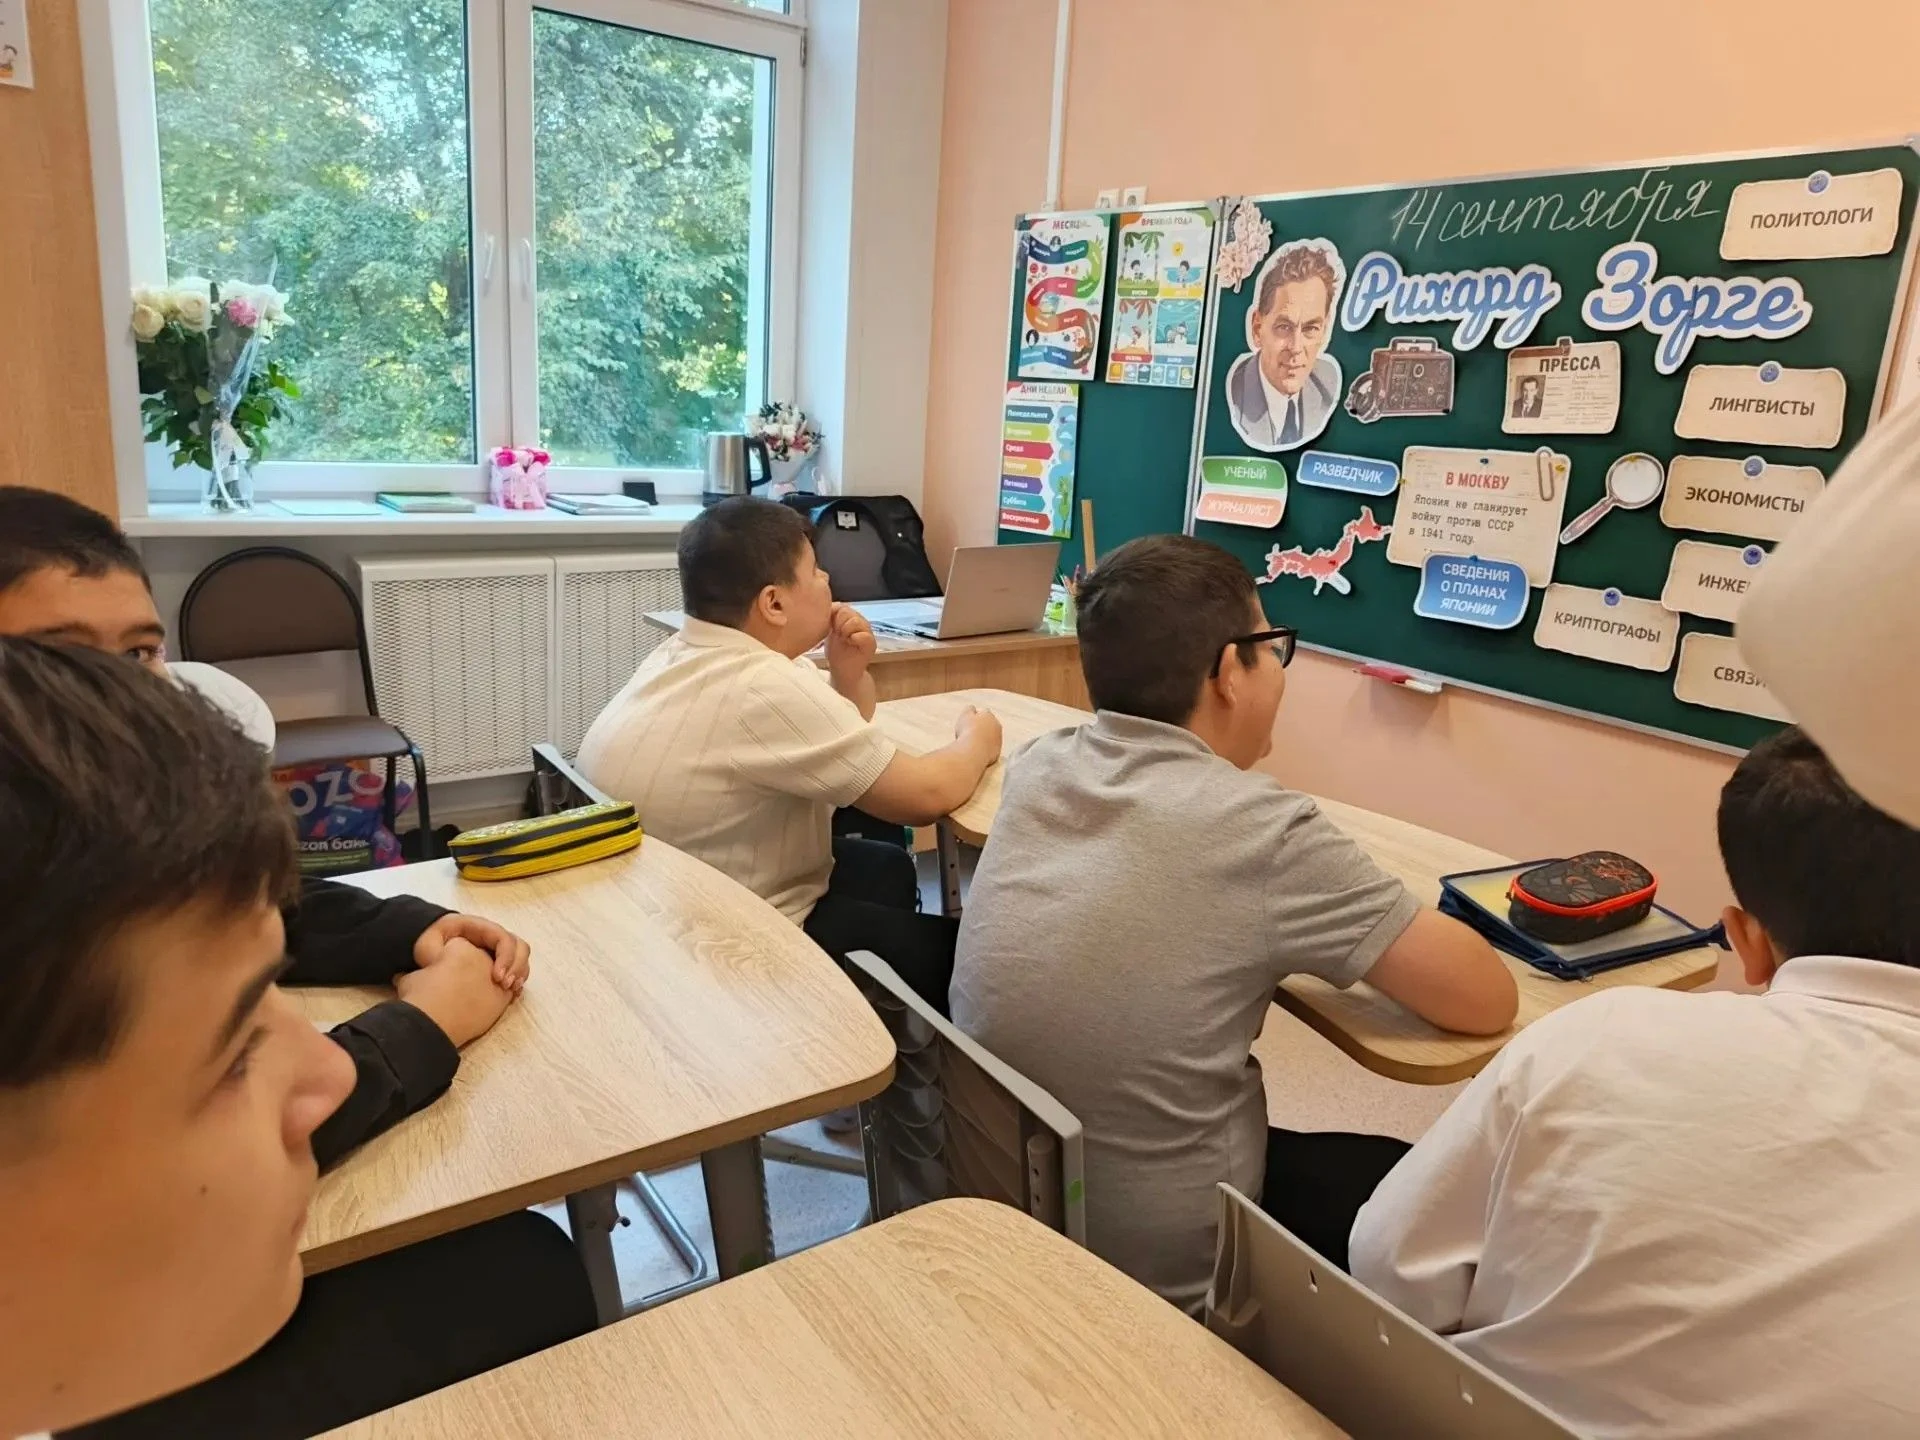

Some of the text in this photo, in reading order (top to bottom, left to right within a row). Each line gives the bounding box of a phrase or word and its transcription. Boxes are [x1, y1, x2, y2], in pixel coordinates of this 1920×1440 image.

[1391, 167, 1721, 251] 14 сентября
[1749, 207, 1874, 230] ПОЛИТОЛОГИ
[1345, 249, 1804, 367] Рихард Зорге
[1539, 356, 1601, 373] ПРЕССА
[1709, 396, 1815, 417] ЛИНГВИСТЫ
[1223, 465, 1268, 481] УЧЕНЫЙ
[1312, 461, 1384, 484] РАЗВЕДЧИК
[1445, 471, 1454, 486] В
[1458, 472, 1510, 490] МОСКВУ
[1207, 499, 1275, 517] ЖУРНАЛИСТ
[1414, 494, 1529, 516] Япония не планирует
[1684, 486, 1805, 513] ЭКОНОМИСТЫ
[1411, 511, 1515, 532] войну против СССР
[1408, 527, 1415, 536] в
[1422, 528, 1444, 540] 1941
[1441, 562, 1510, 584] СВЕДЕНИЯ
[1698, 573, 1751, 594] ИНЖЕ
[1440, 580, 1508, 601] О ПЛАНАХ
[1440, 597, 1498, 616] ЯПОНИИ
[1553, 611, 1661, 643] КРИПТОГРАФЫ
[287, 770, 386, 816] OZO
